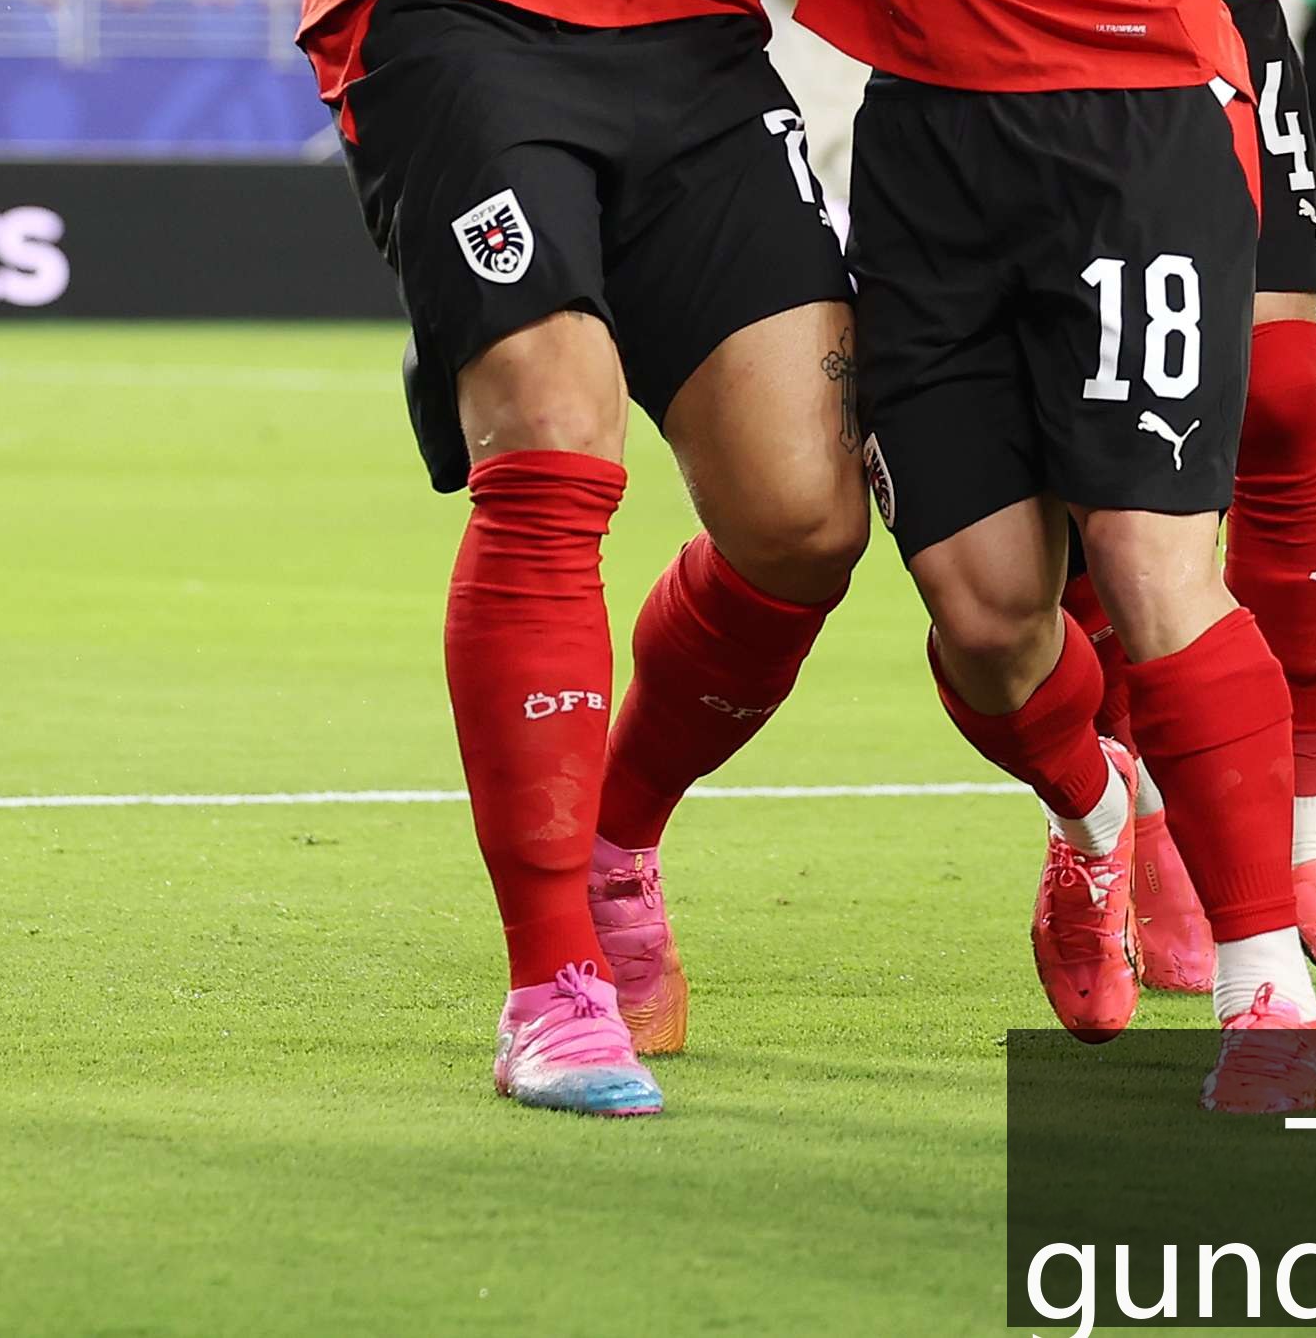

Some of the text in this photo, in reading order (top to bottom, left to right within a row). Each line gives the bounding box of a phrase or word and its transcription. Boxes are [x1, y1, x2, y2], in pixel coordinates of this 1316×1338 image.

[763, 108, 815, 203] 7
[1258, 60, 1316, 191] 4
[1080, 254, 1201, 401] 18
